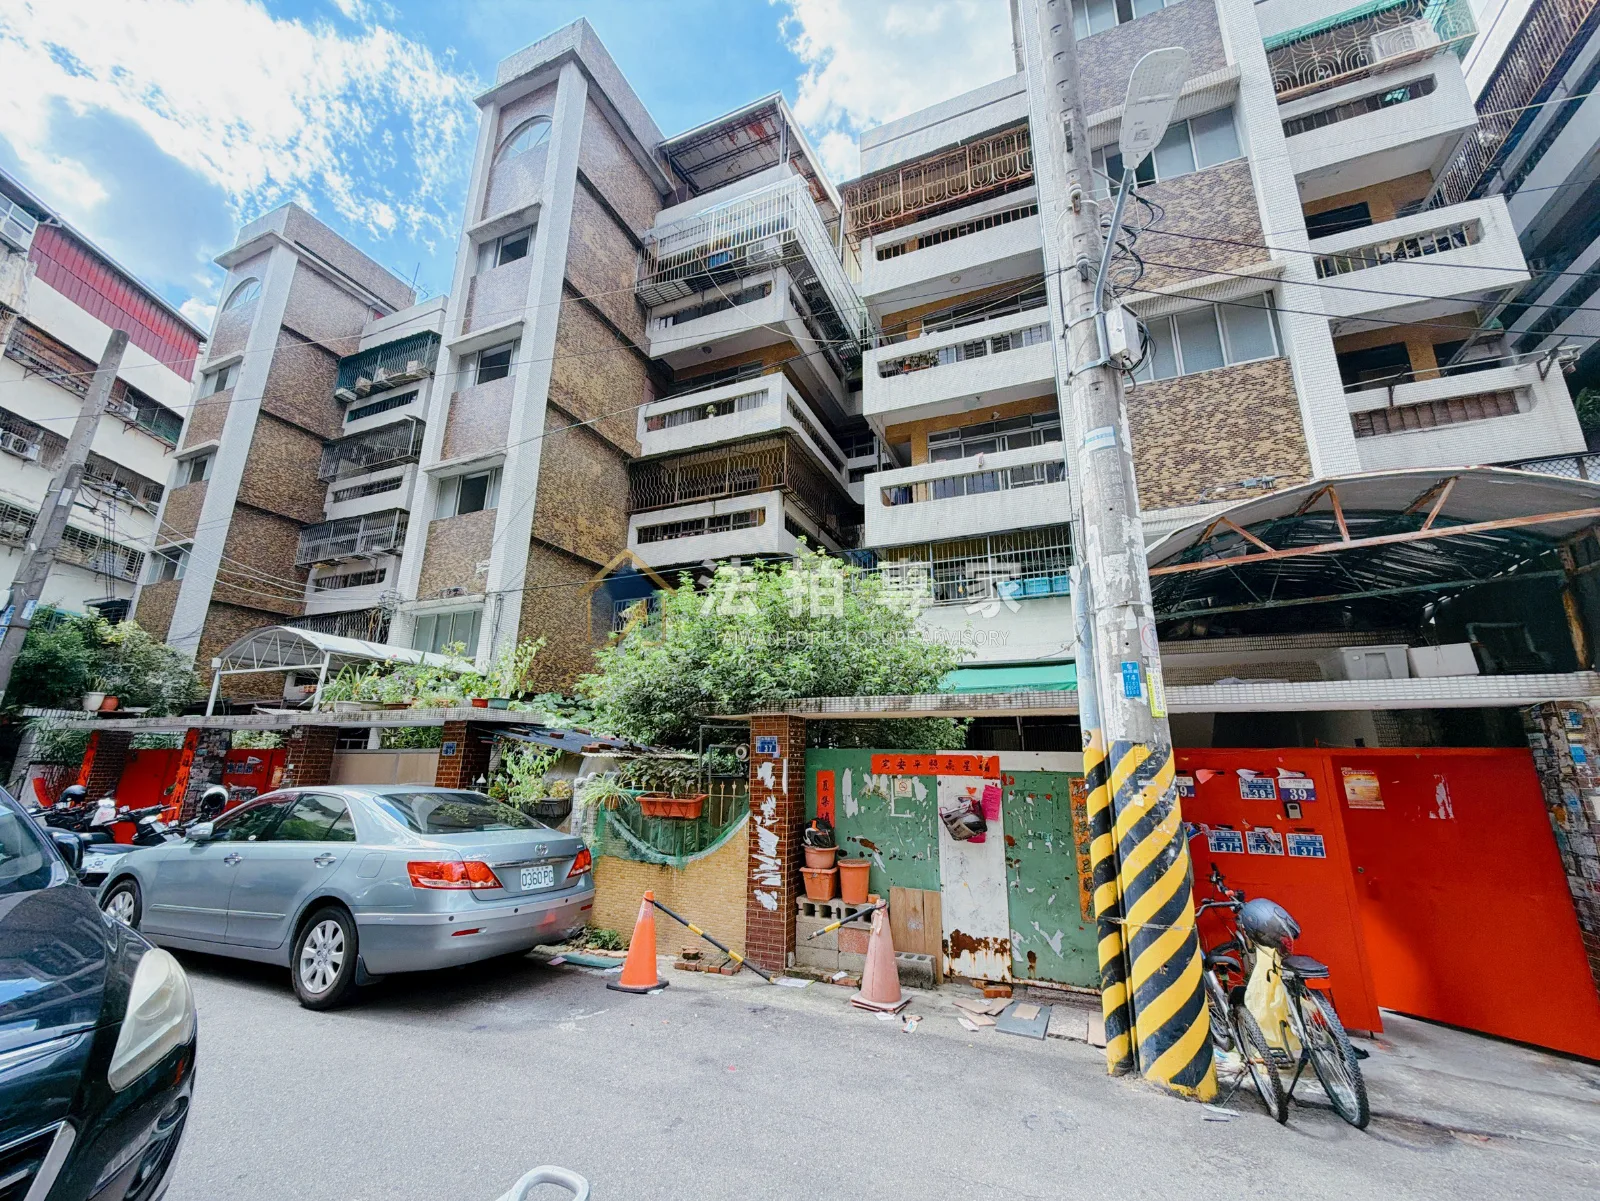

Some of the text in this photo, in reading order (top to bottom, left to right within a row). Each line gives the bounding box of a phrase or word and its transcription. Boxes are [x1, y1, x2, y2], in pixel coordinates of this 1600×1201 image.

[1254, 789, 1266, 799] 39
[1289, 788, 1307, 801] 39
[1220, 842, 1233, 852] 37
[1300, 846, 1314, 856] 37
